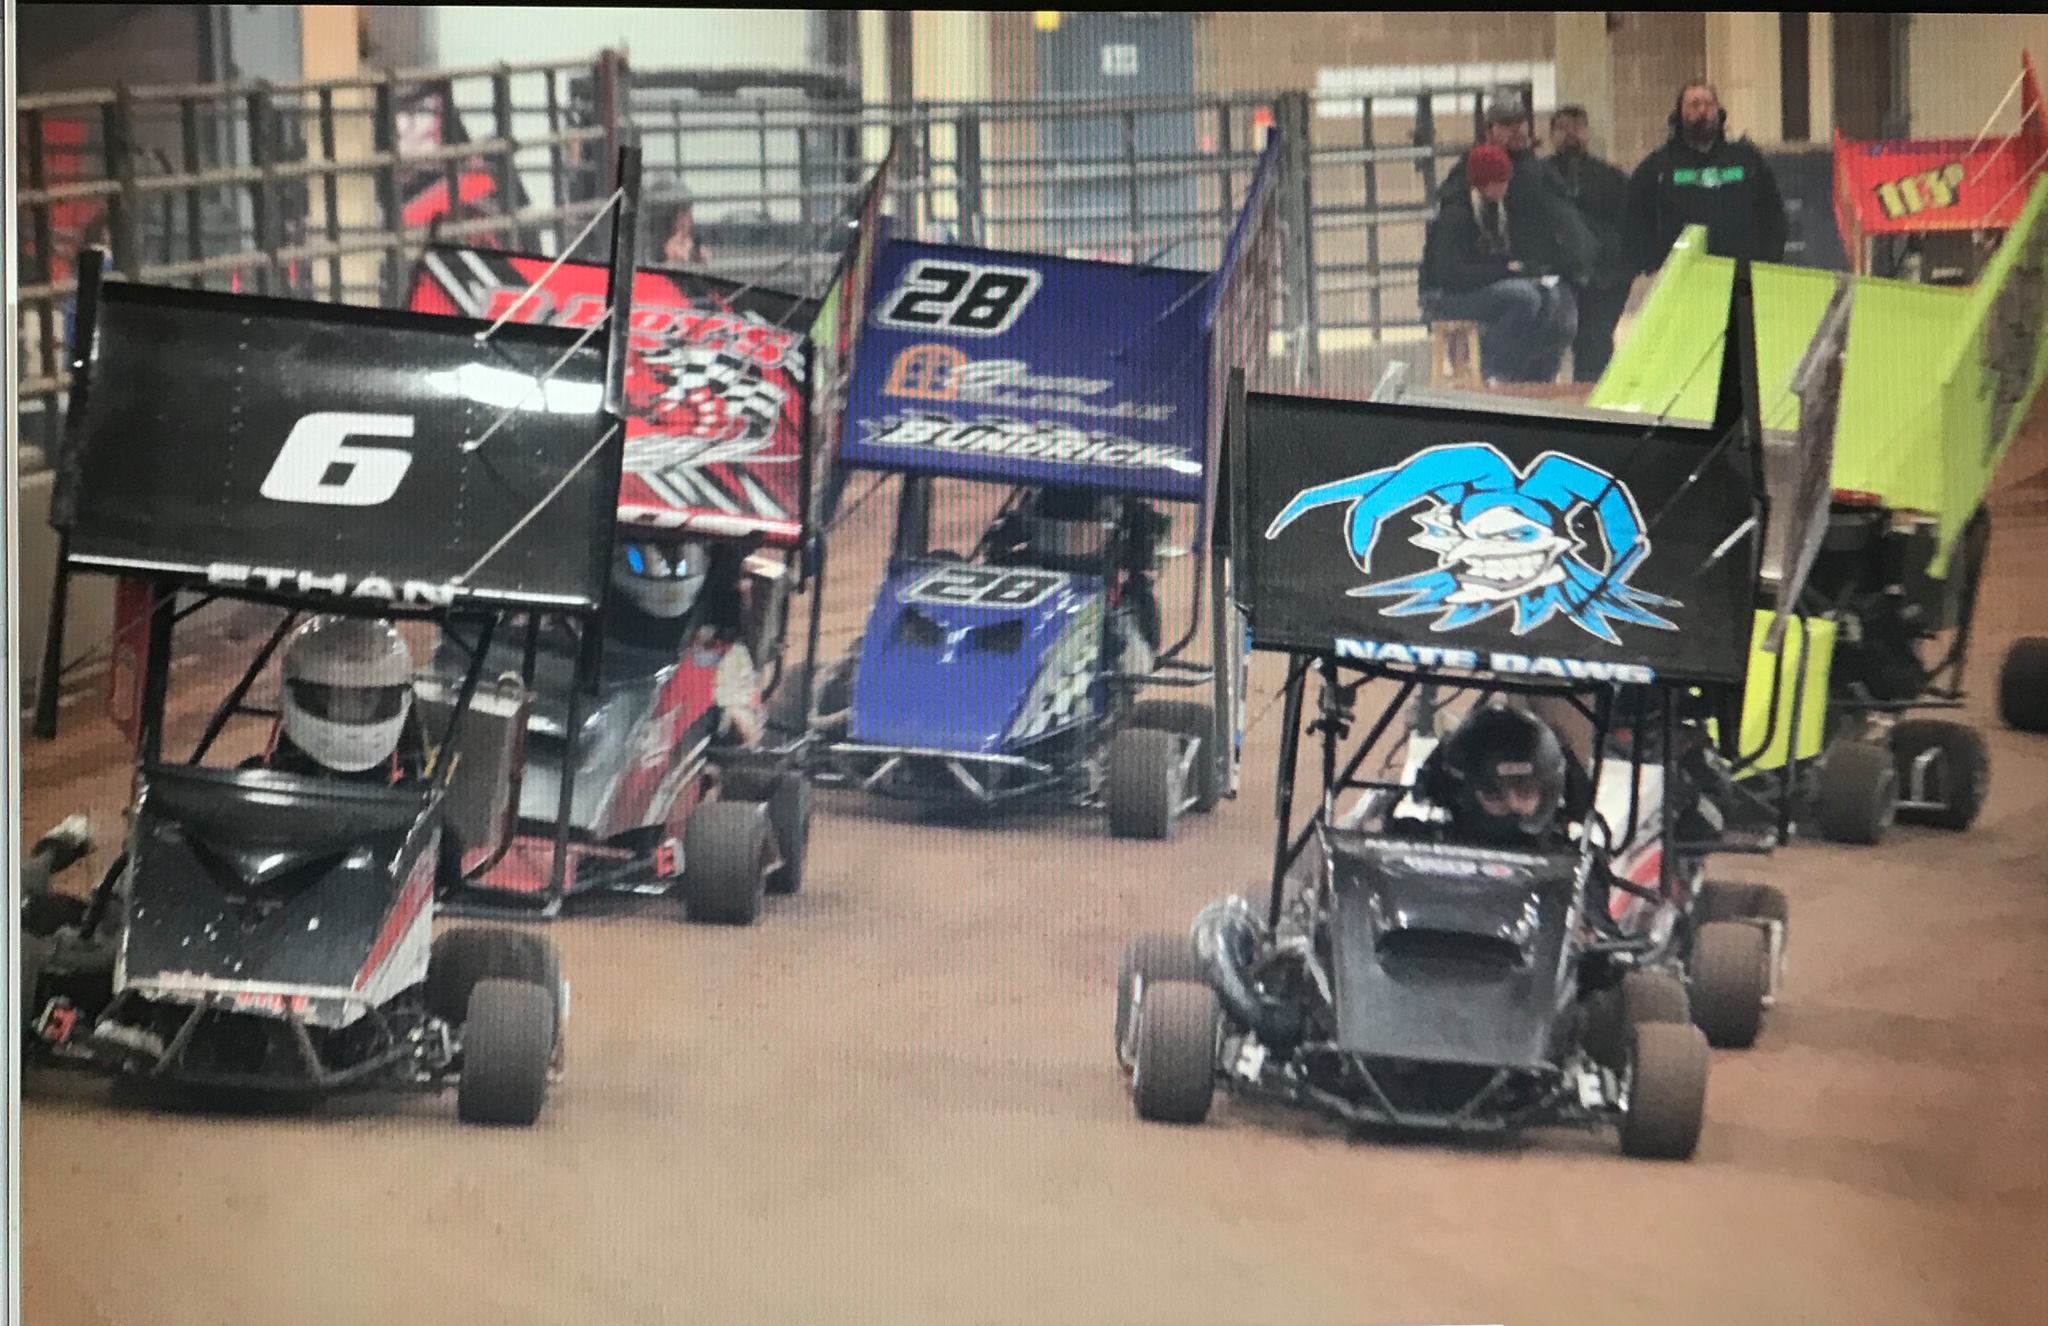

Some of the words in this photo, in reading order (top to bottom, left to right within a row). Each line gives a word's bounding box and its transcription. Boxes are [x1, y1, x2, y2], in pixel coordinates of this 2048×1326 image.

[886, 262, 1034, 333] 28
[259, 411, 415, 506] 6
[914, 567, 1063, 605] 28
[1334, 637, 1478, 668] NATE
